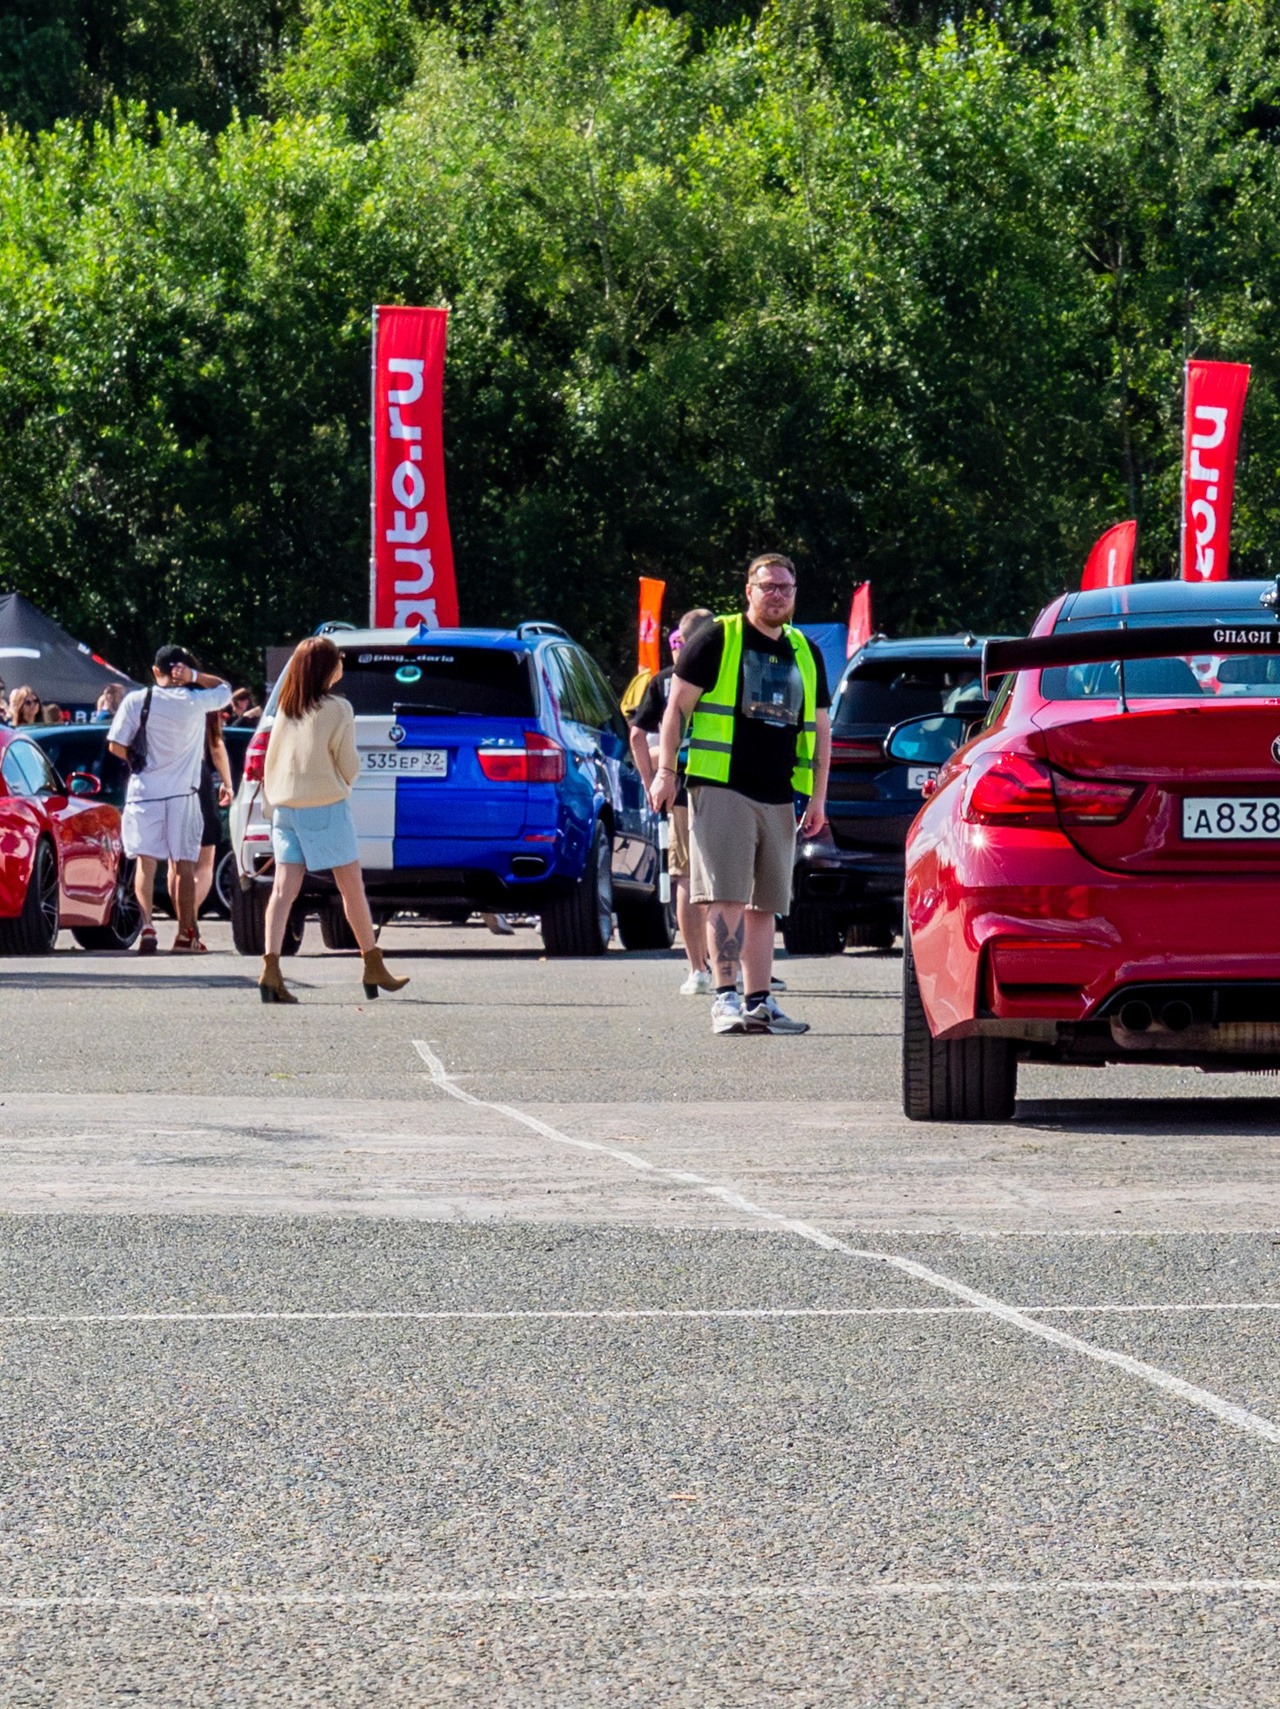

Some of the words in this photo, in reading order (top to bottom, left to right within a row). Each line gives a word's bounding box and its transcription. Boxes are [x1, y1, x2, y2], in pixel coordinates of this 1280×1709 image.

[1213, 630, 1271, 644] СПАСИ
[361, 753, 419, 769] 535ЕР
[424, 753, 440, 766] 32
